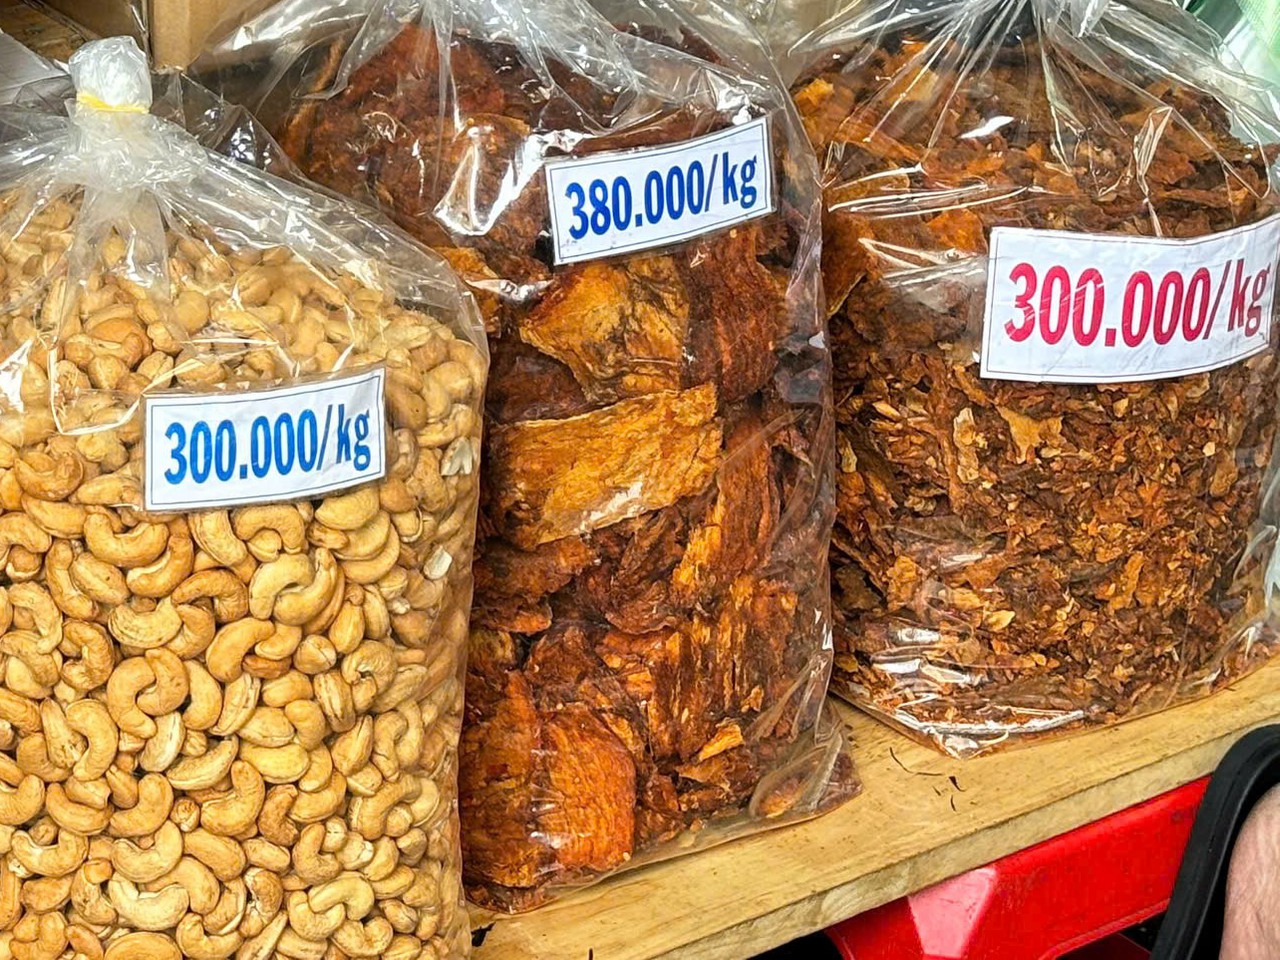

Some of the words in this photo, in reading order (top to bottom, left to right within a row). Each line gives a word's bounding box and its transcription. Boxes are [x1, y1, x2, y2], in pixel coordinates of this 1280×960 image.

[565, 151, 757, 239] 380.000/kg
[1004, 258, 1271, 348] 300.000/kg
[164, 403, 370, 485] 300.000/kg
